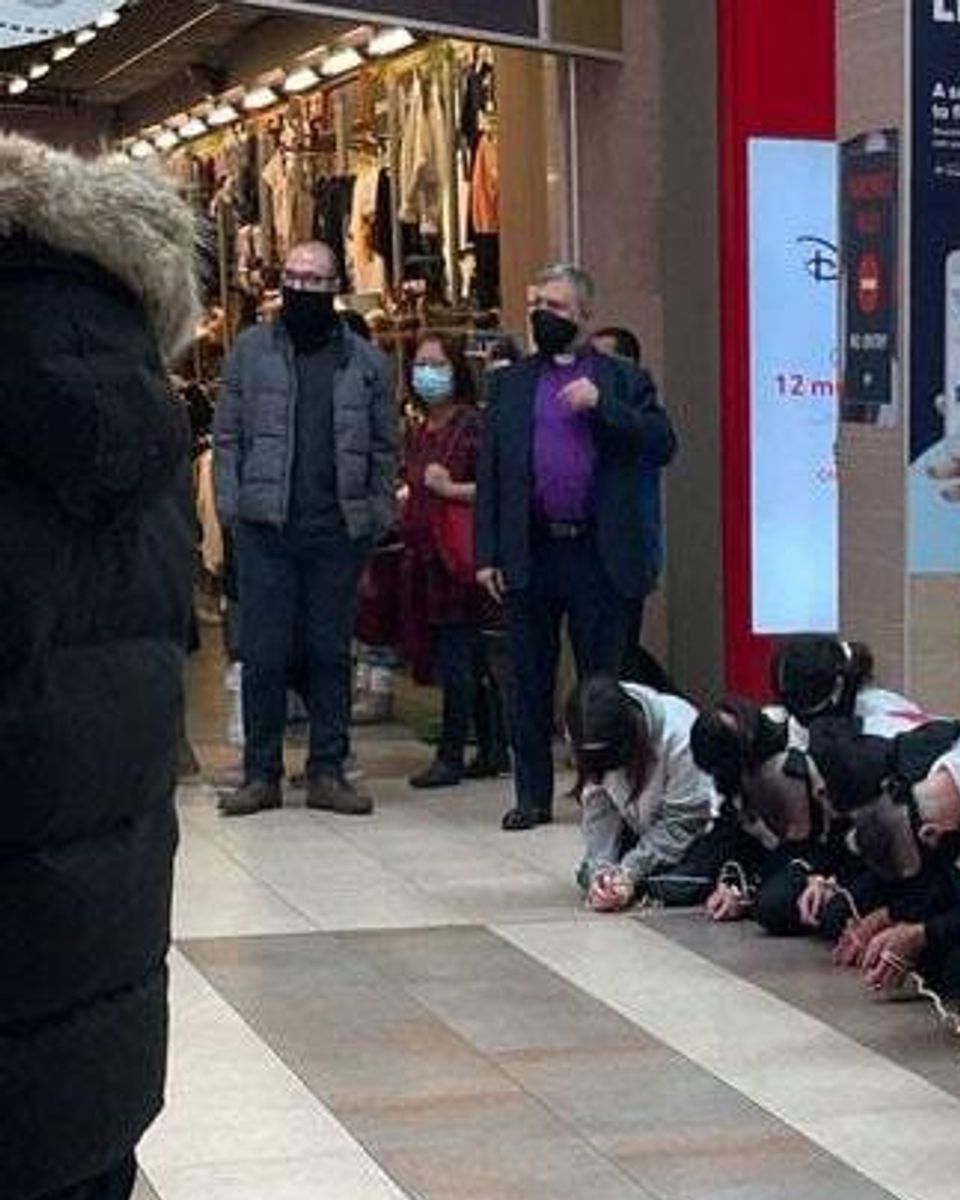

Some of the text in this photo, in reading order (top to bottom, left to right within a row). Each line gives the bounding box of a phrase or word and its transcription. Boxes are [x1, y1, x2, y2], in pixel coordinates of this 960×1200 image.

[932, 82, 946, 97] A
[932, 104, 949, 119] to
[777, 374, 804, 396] 12
